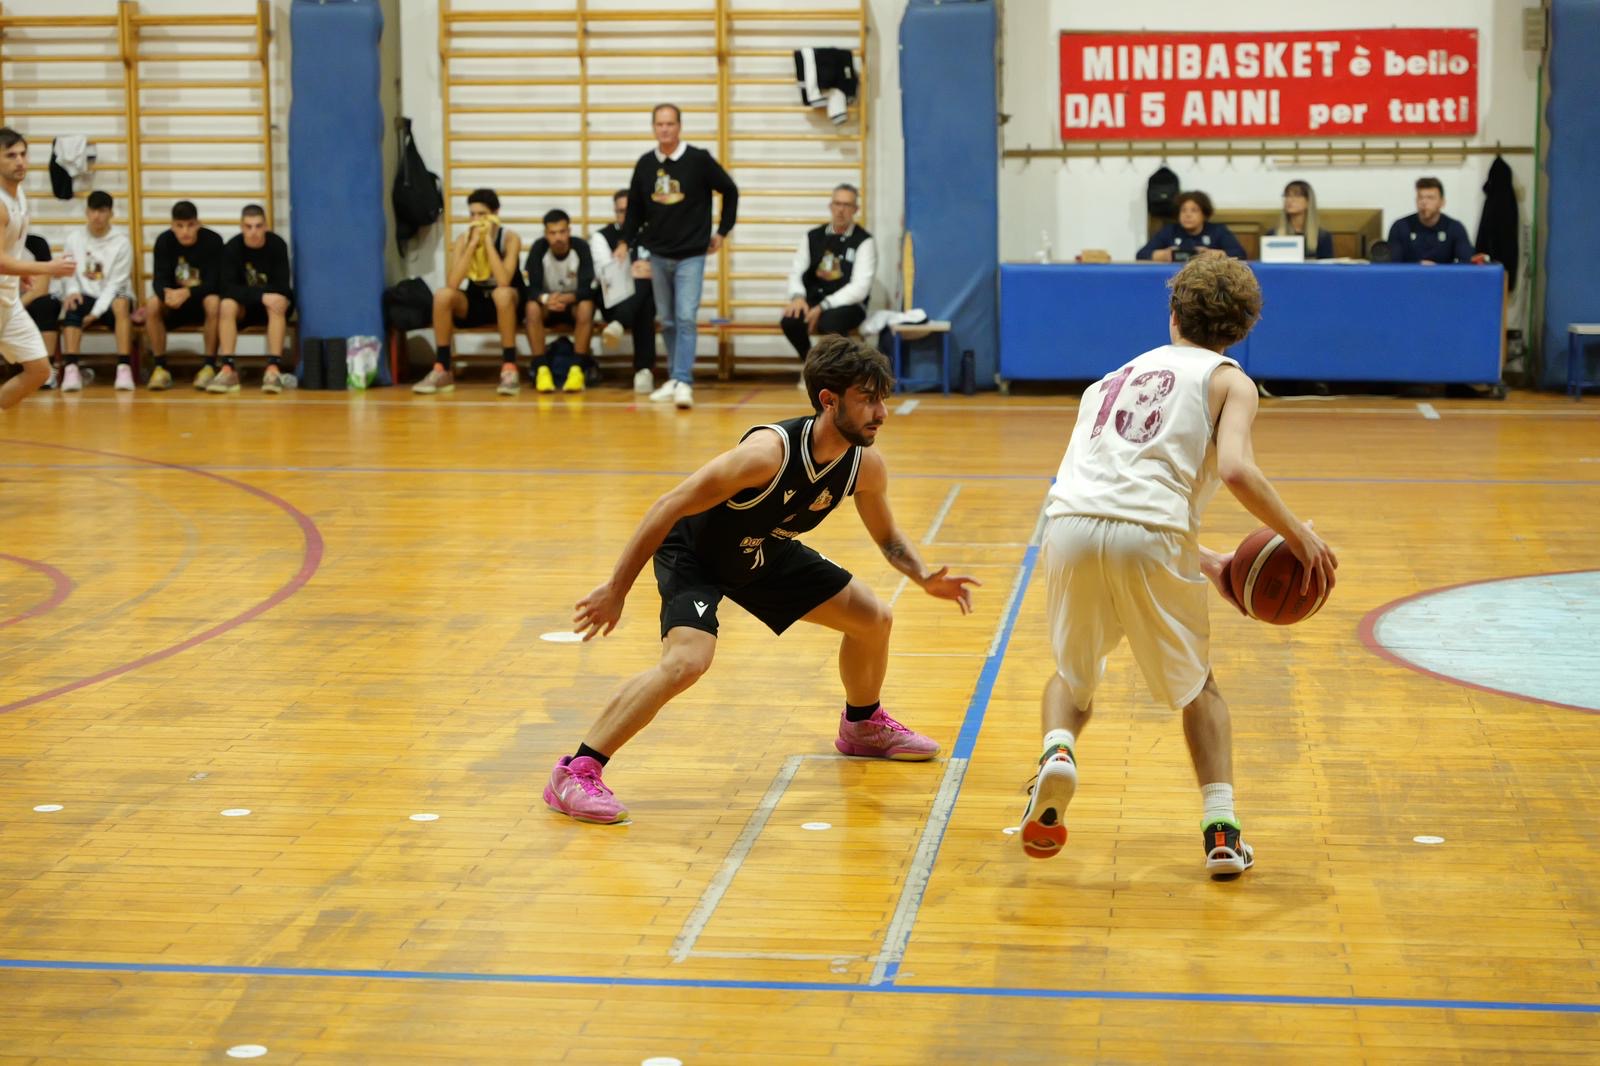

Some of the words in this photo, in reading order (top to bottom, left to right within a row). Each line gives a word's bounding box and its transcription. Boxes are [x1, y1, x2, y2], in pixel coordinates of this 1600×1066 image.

[1349, 45, 1372, 76] è
[1065, 92, 1126, 129] DAI
[1140, 91, 1166, 127] 5
[1181, 88, 1281, 127] ANNI
[1308, 103, 1369, 130] per
[1388, 96, 1470, 123] tutti
